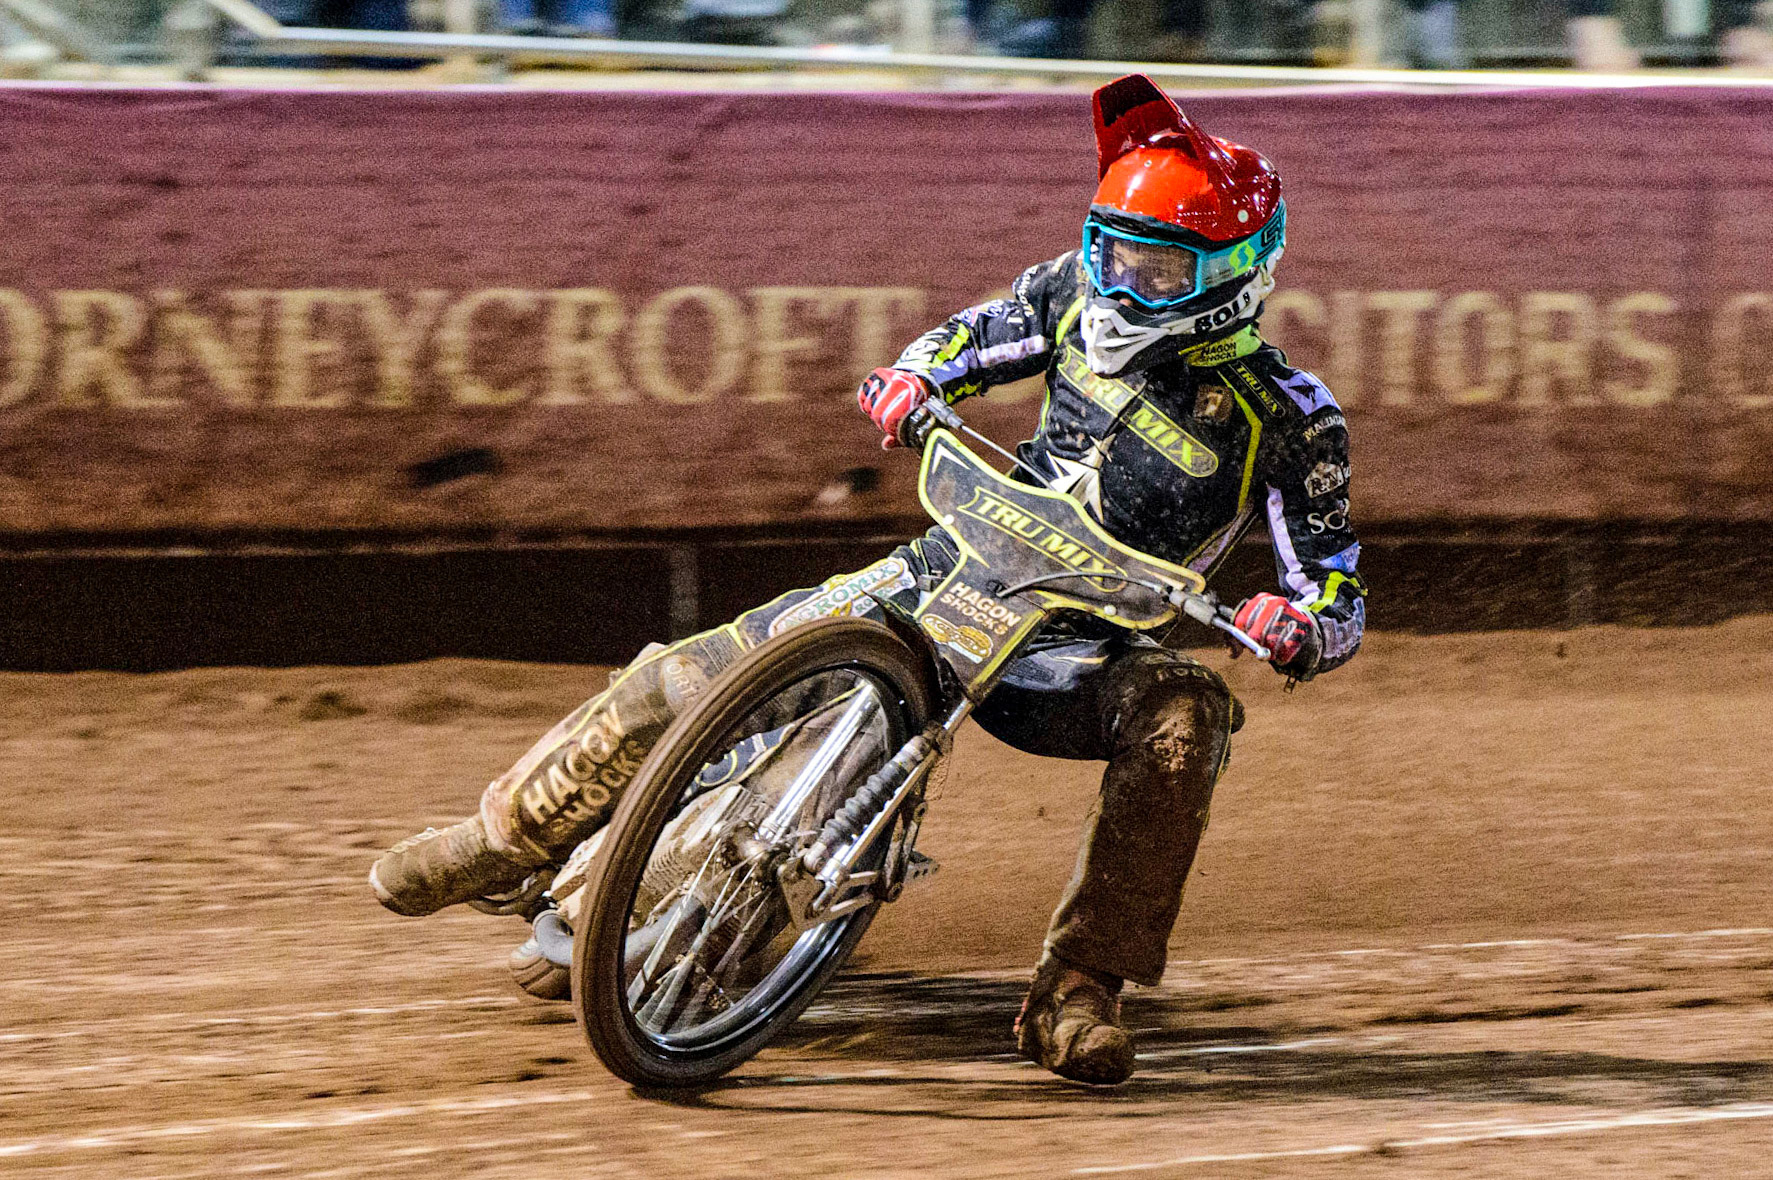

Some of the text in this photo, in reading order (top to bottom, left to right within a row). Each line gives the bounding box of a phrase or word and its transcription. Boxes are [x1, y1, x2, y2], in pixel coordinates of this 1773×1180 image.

[1130, 407, 1204, 469] MIX
[977, 497, 1117, 582] TRU MIX
[782, 565, 898, 630] AGROMIX
[940, 593, 1008, 635] SHOCKS
[949, 581, 1022, 627] HAGON
